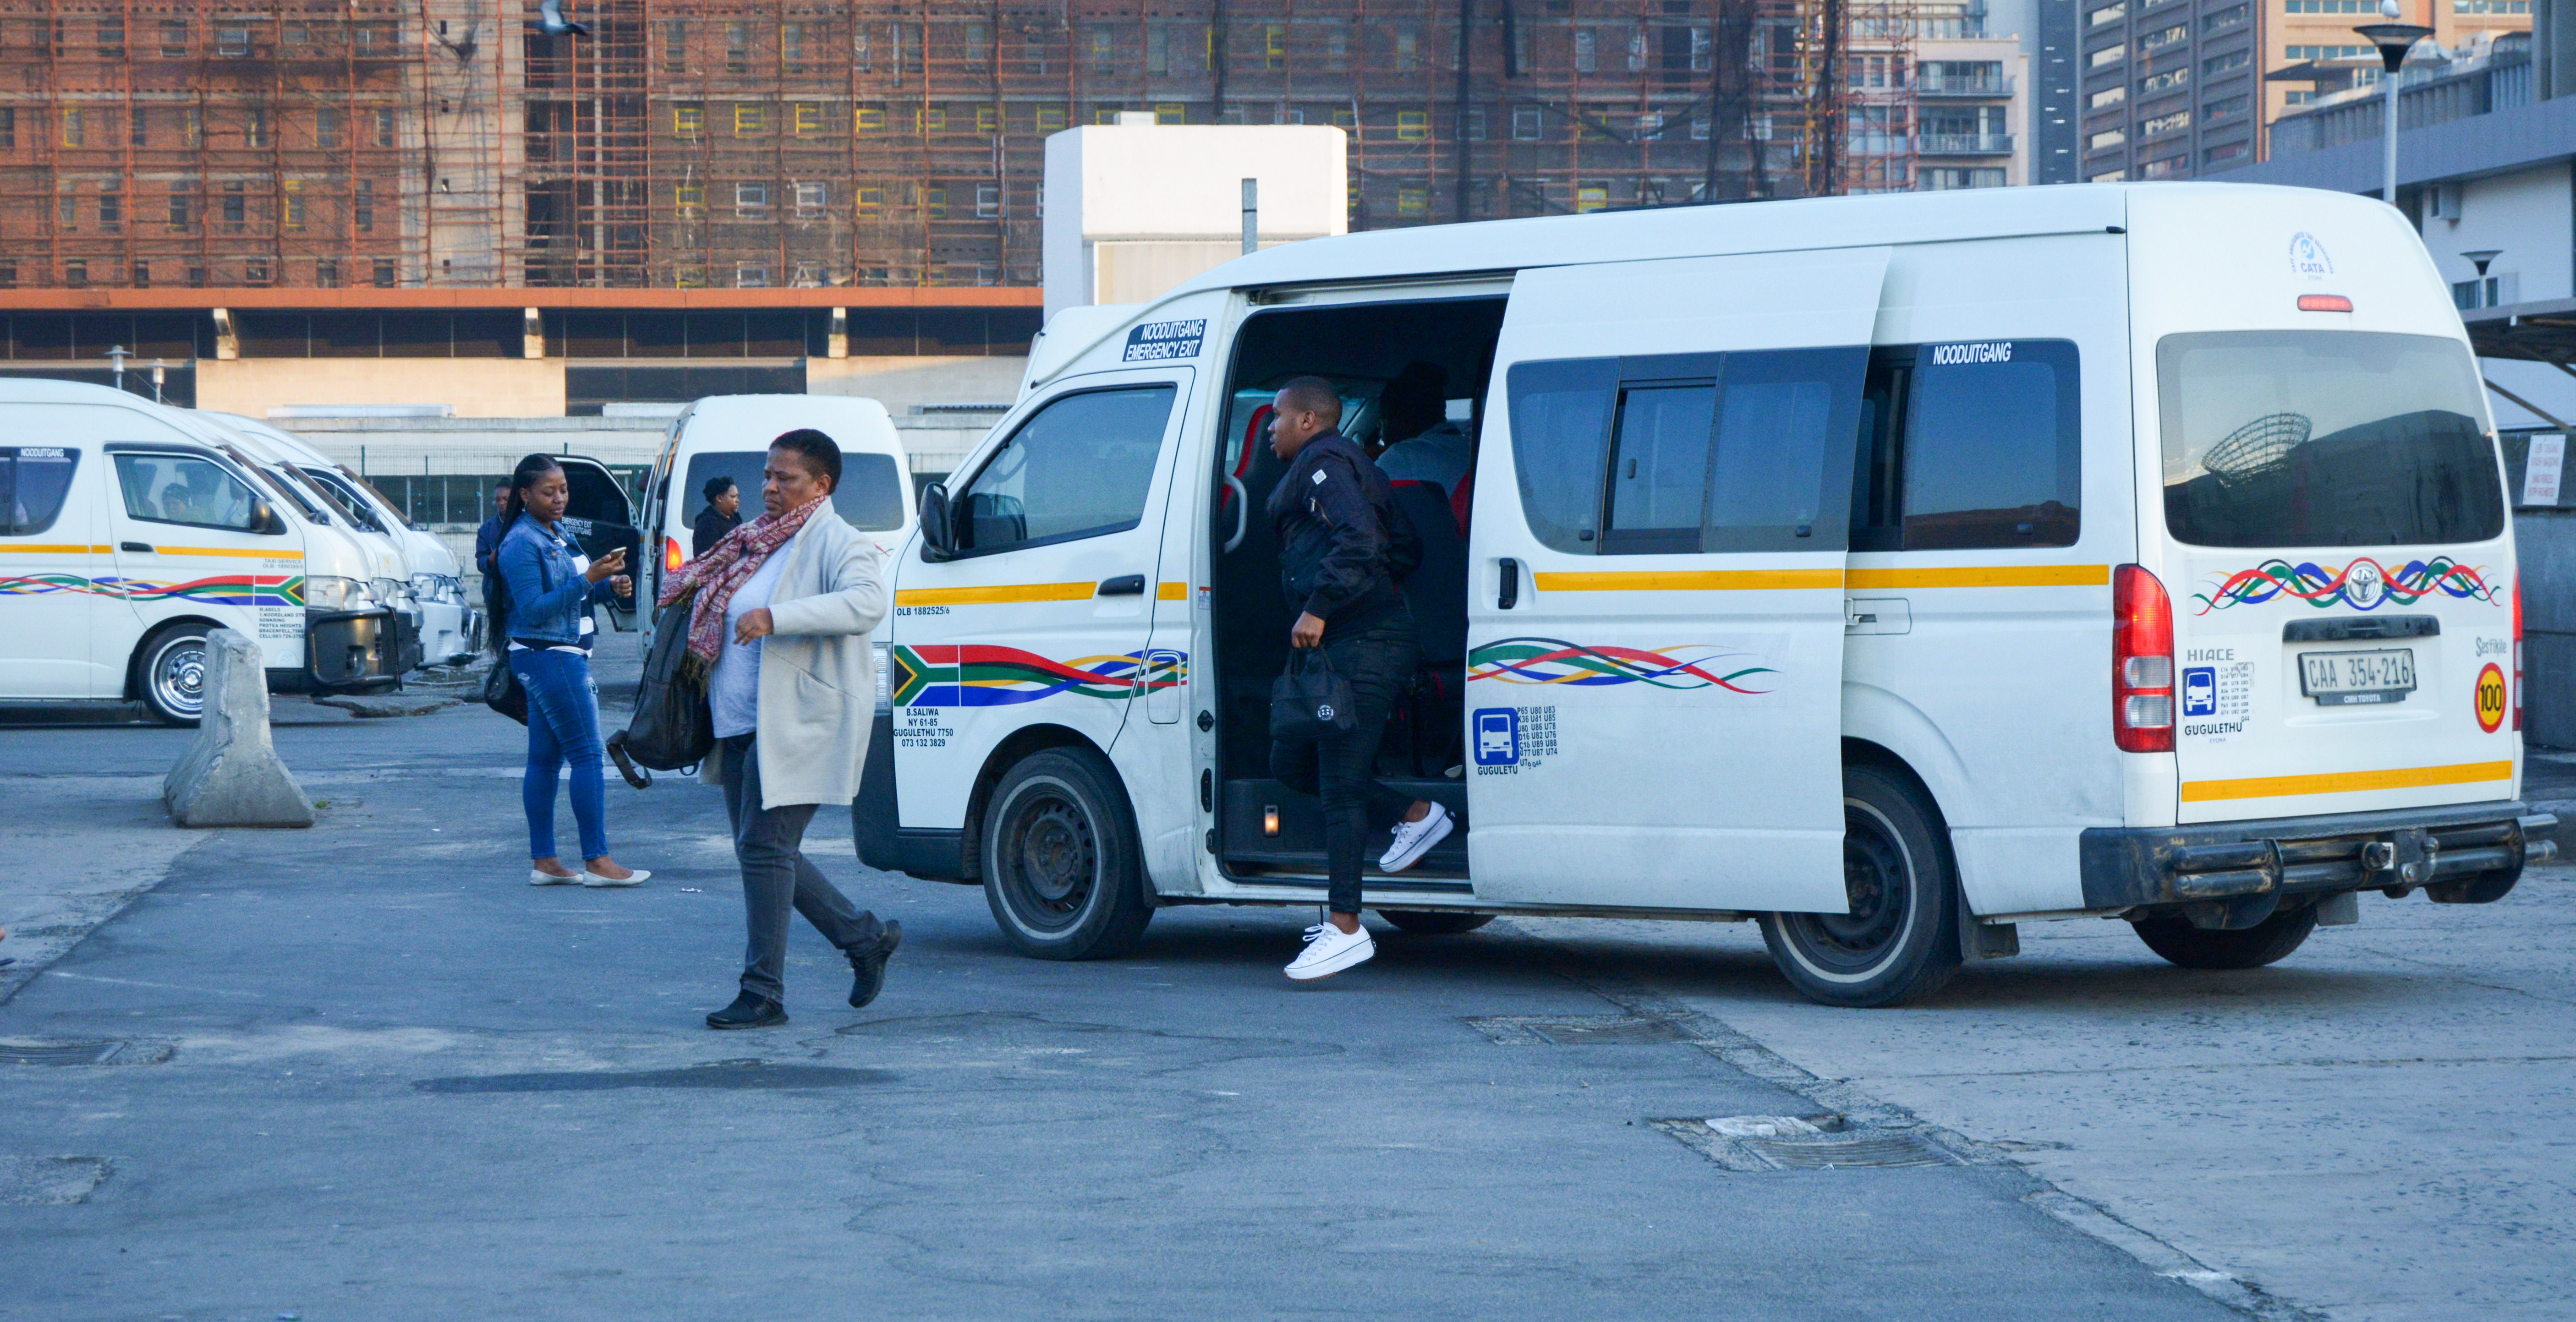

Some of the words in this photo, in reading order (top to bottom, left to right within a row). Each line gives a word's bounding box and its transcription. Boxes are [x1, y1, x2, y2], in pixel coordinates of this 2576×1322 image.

[2301, 262, 2325, 273] CATA
[1141, 320, 1204, 340] NOODUITGANG
[1126, 341, 1180, 361] EMERGENCY
[1178, 339, 1200, 357] EXIT
[1933, 342, 2011, 365] NOODUITGANG
[21, 448, 64, 457] NOODUITGANG
[897, 607, 911, 616] OLB
[914, 606, 949, 615] 1882525/6
[2187, 649, 2234, 661] HIACE
[2309, 660, 2338, 688] CAA
[2348, 656, 2409, 687] 354-216
[2344, 695, 2357, 703] CMH
[2480, 684, 2502, 711] 100
[937, 728, 954, 737] 7750
[2185, 722, 2242, 736] GUGULETHU
[1478, 765, 1518, 776] GUGULETU
